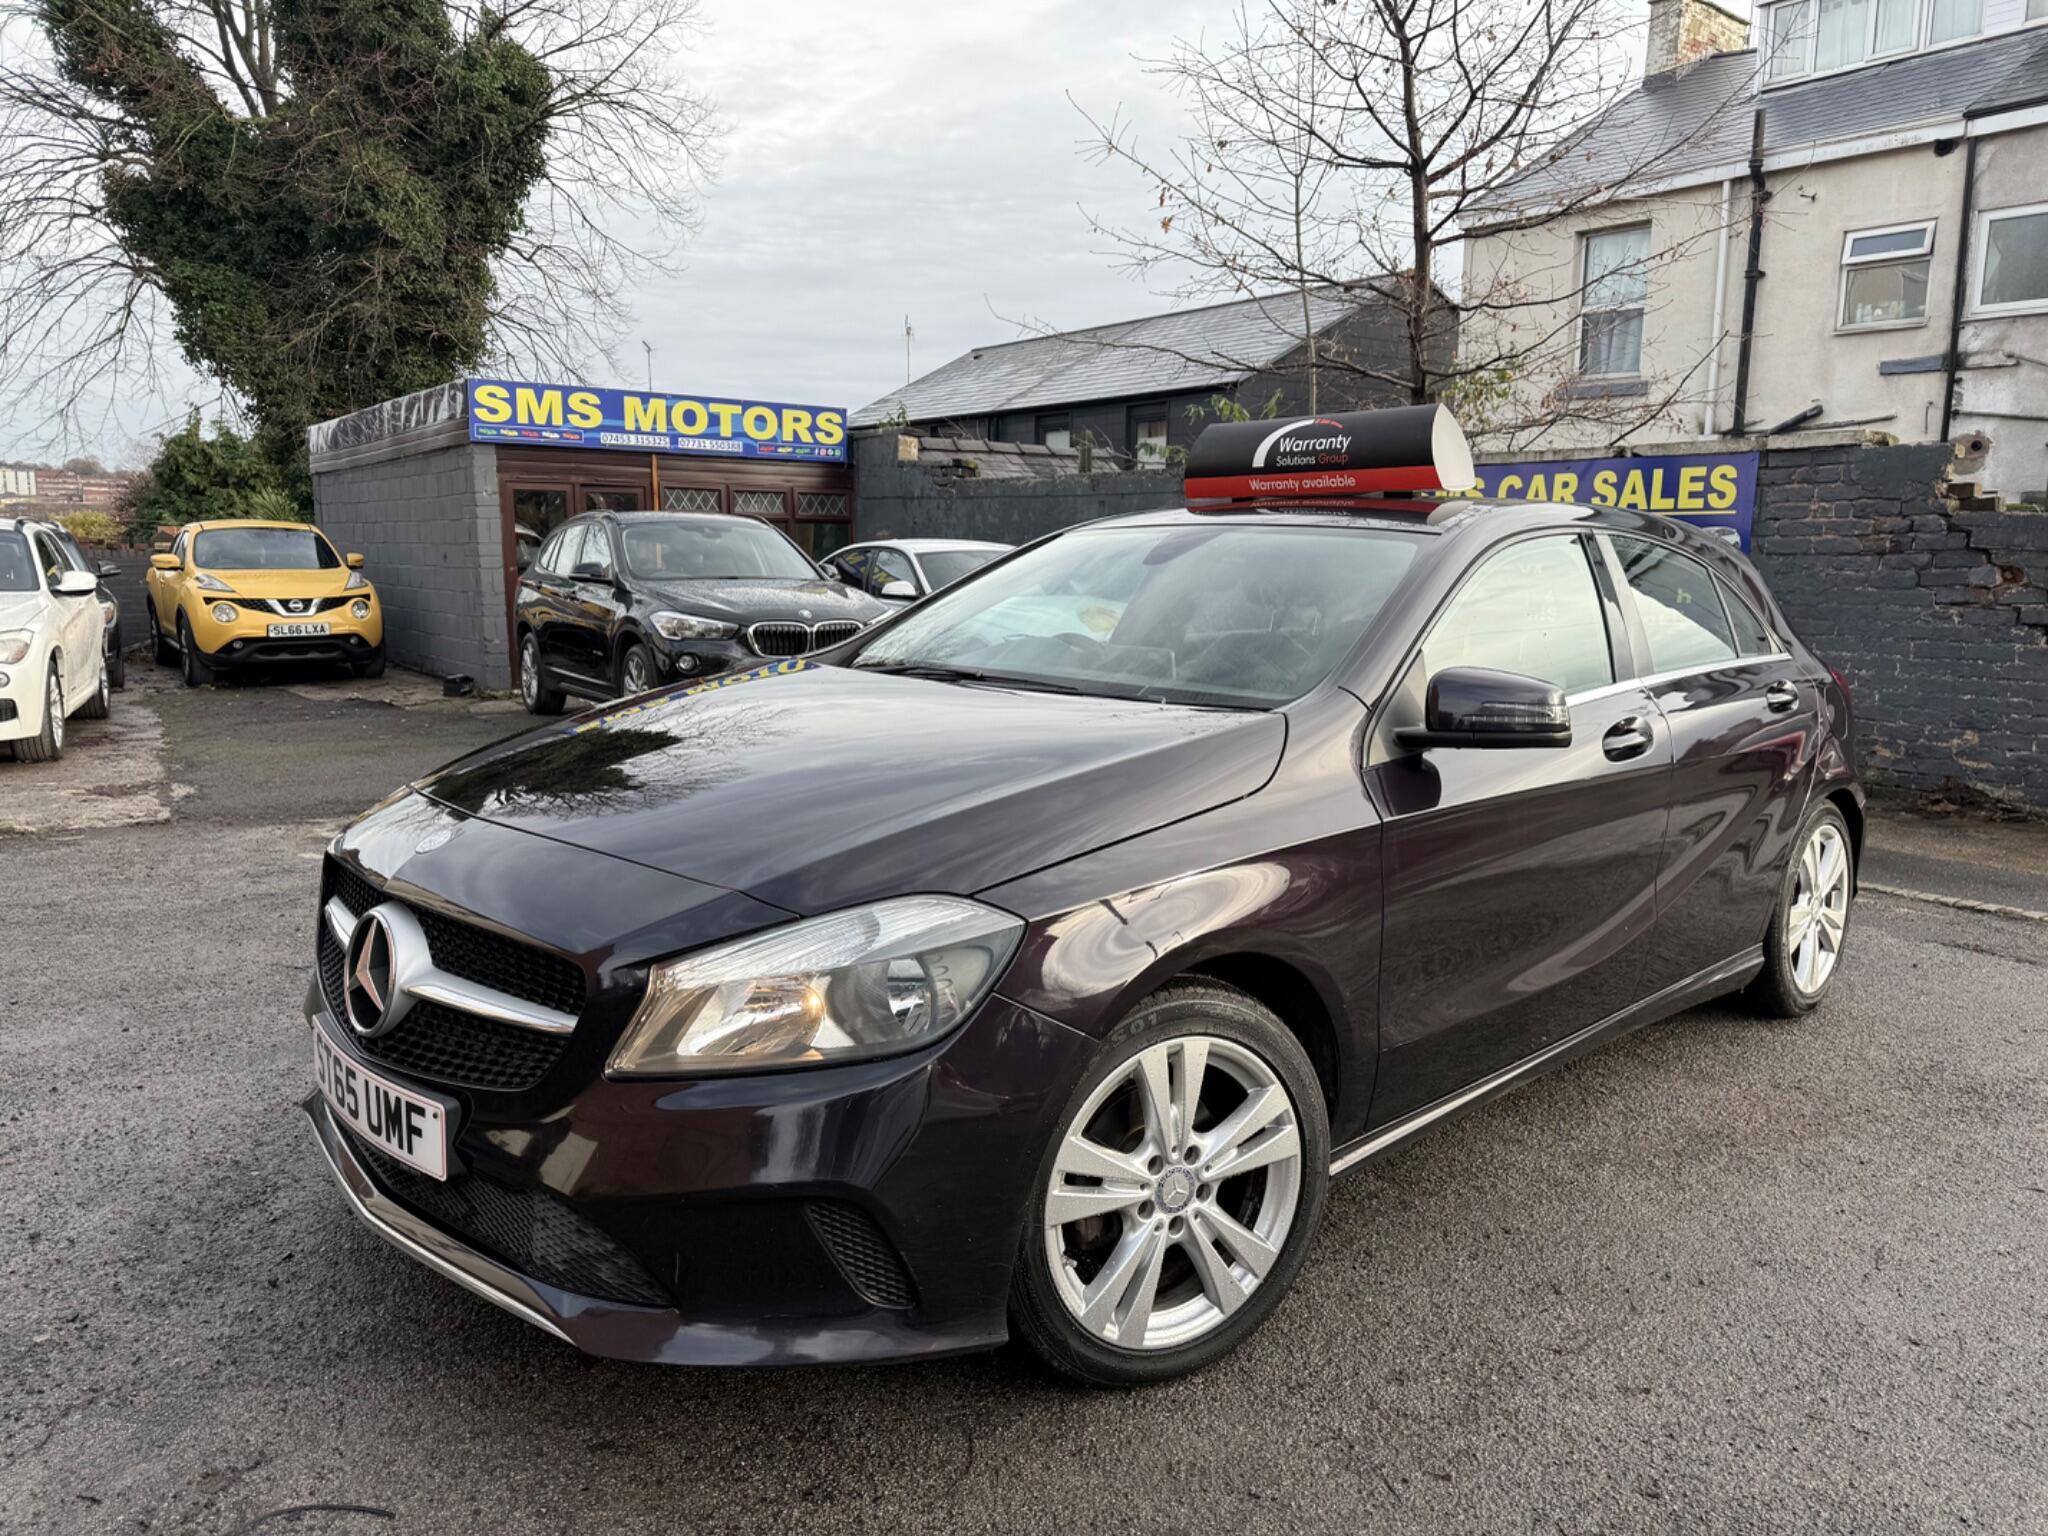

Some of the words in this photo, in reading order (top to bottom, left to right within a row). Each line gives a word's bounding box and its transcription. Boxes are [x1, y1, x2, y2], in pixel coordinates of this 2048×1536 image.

[474, 385, 604, 428] SMS
[623, 396, 844, 445] MOTORS
[1279, 434, 1351, 453] Warranty
[1276, 455, 1316, 467] Solutions
[1318, 453, 1349, 465] Group
[1249, 477, 1299, 491] Warranty
[1302, 474, 1356, 488] available
[1498, 473, 1579, 502] CAR
[1591, 465, 1739, 511] SALES
[273, 624, 302, 635] SL66
[305, 624, 326, 635] LXA
[316, 1032, 359, 1120] ST65
[364, 1079, 426, 1155] UMF
